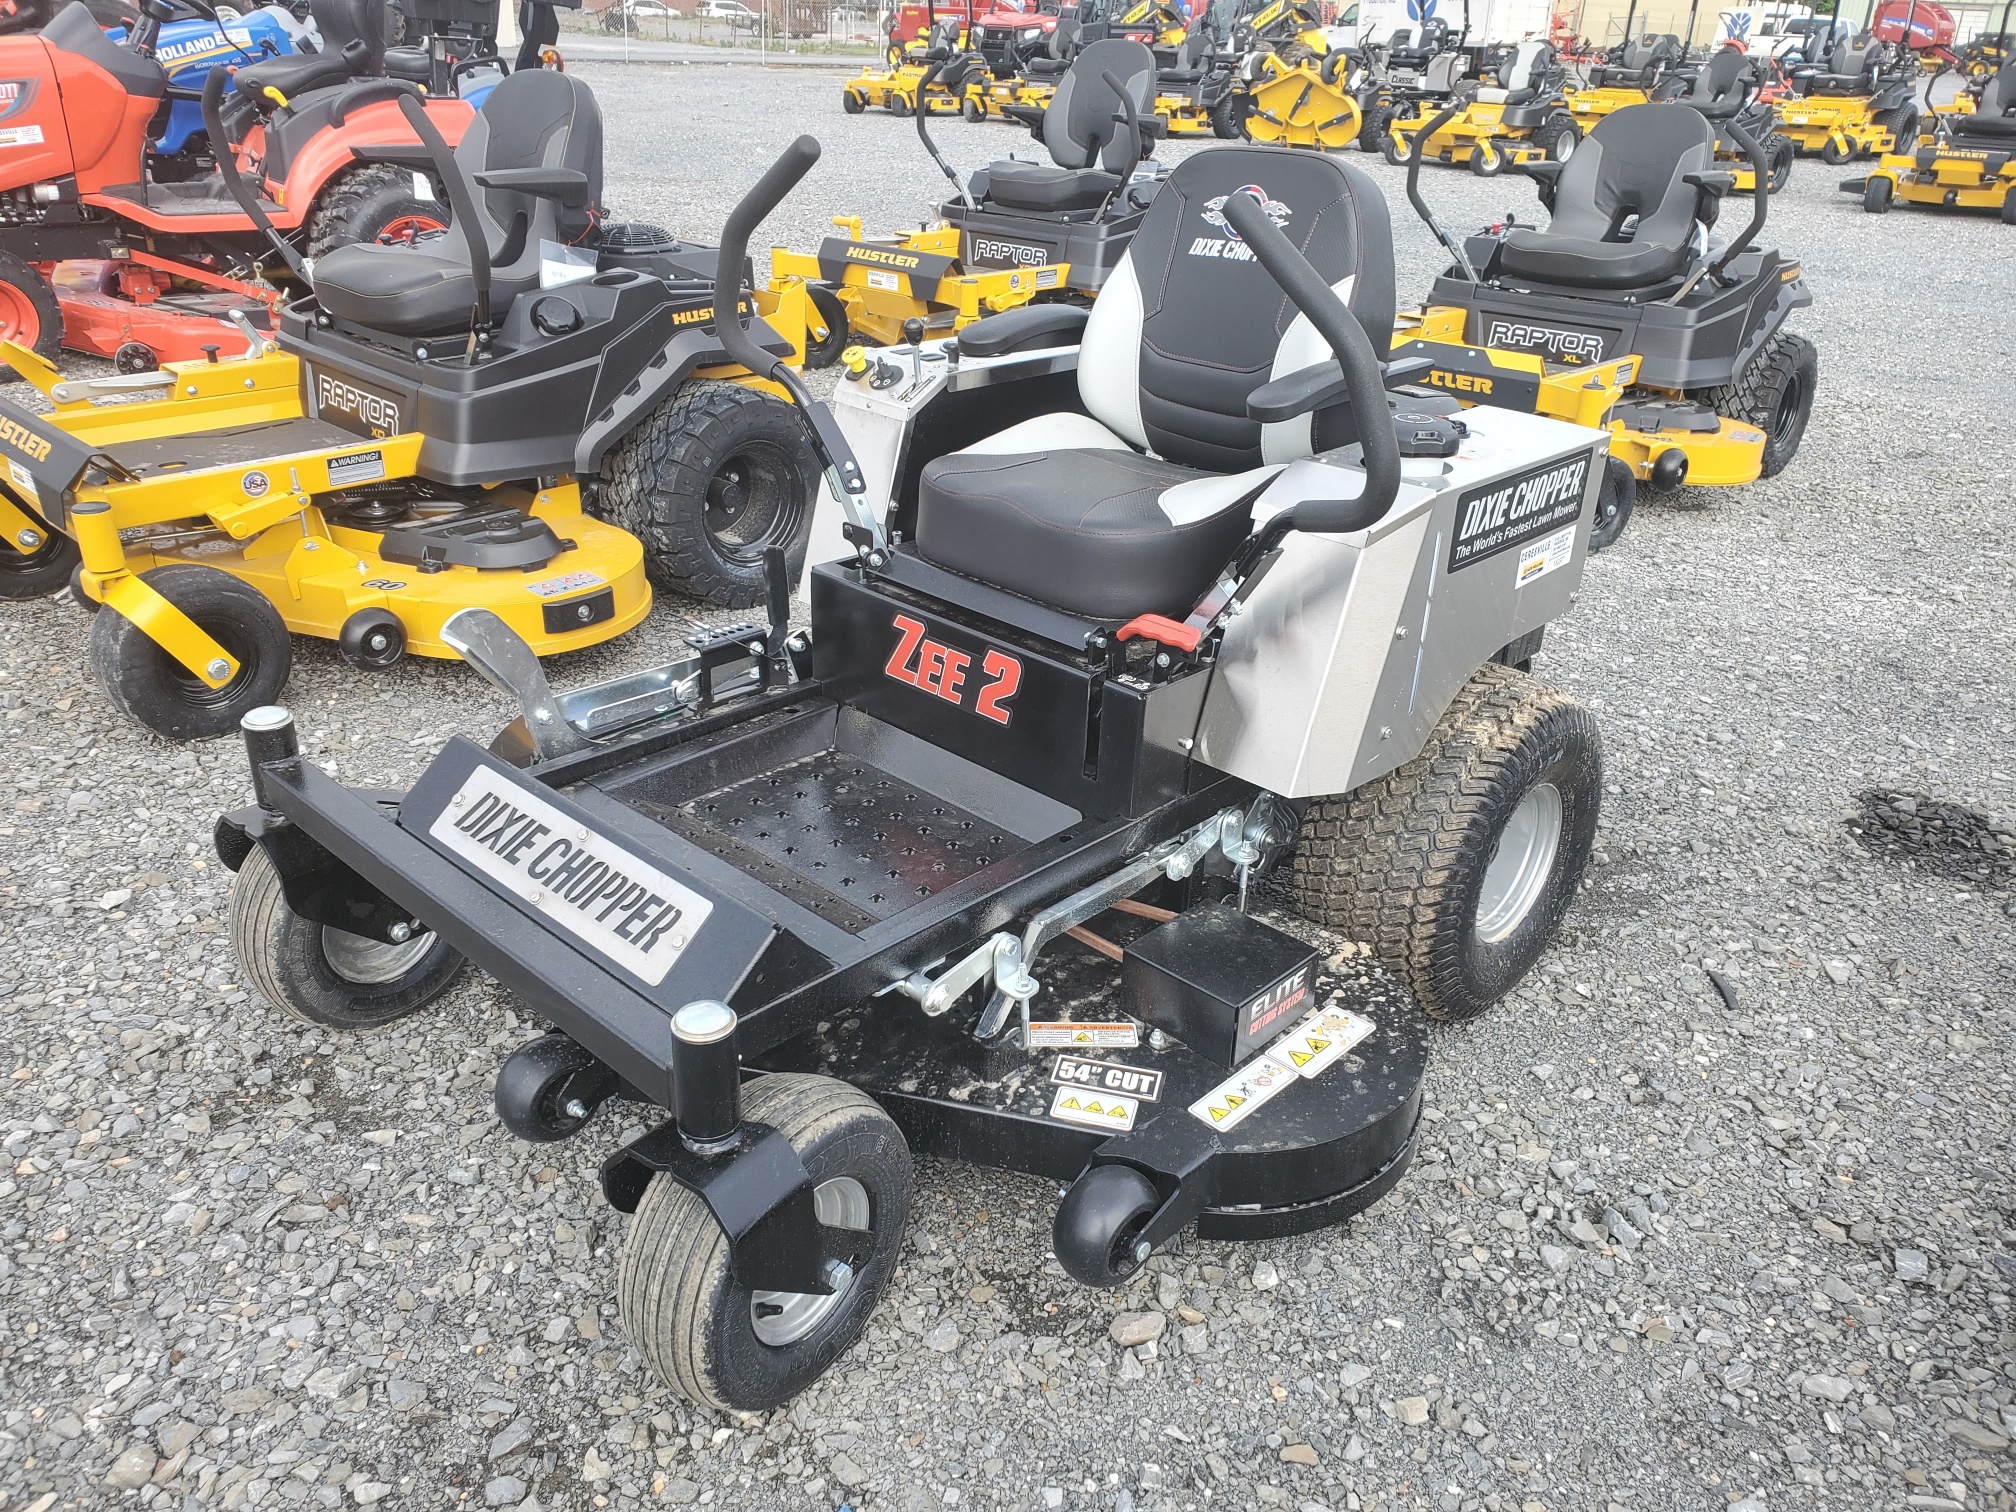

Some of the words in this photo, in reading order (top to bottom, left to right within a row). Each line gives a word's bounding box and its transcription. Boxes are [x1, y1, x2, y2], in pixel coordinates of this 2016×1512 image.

[1391, 75, 1415, 85] CLASSIC
[1935, 150, 1989, 160] HUSTLER
[846, 246, 919, 269] HUSTLER
[974, 239, 1048, 268] RAPTOR
[1187, 237, 1227, 258] DIXIE
[1487, 321, 1604, 364] RAPTOR
[1562, 353, 1582, 364] XL
[319, 373, 399, 438] RAPTOR
[337, 452, 379, 467] WARNING!
[243, 477, 268, 490] USA
[1459, 487, 1514, 541] DIXIE
[1509, 460, 1586, 520] CHOPPER
[1455, 545, 1471, 560] The
[1473, 528, 1502, 553] World's
[1504, 518, 1533, 541] Fastest
[1532, 511, 1553, 527] Lawn
[1521, 540, 1551, 563] CERESVILLE
[361, 579, 408, 590] 60
[885, 614, 972, 705] ZEE
[975, 649, 1022, 725] 2
[453, 791, 552, 866] DIXIE
[527, 838, 683, 954] CHOPPER
[1250, 966, 1308, 1021] ELITE
[1248, 1006, 1278, 1036] CUTTING
[1278, 986, 1305, 1016] SYSTEM
[1058, 1060, 1103, 1082] 54"
[1104, 1068, 1155, 1093] CUT
